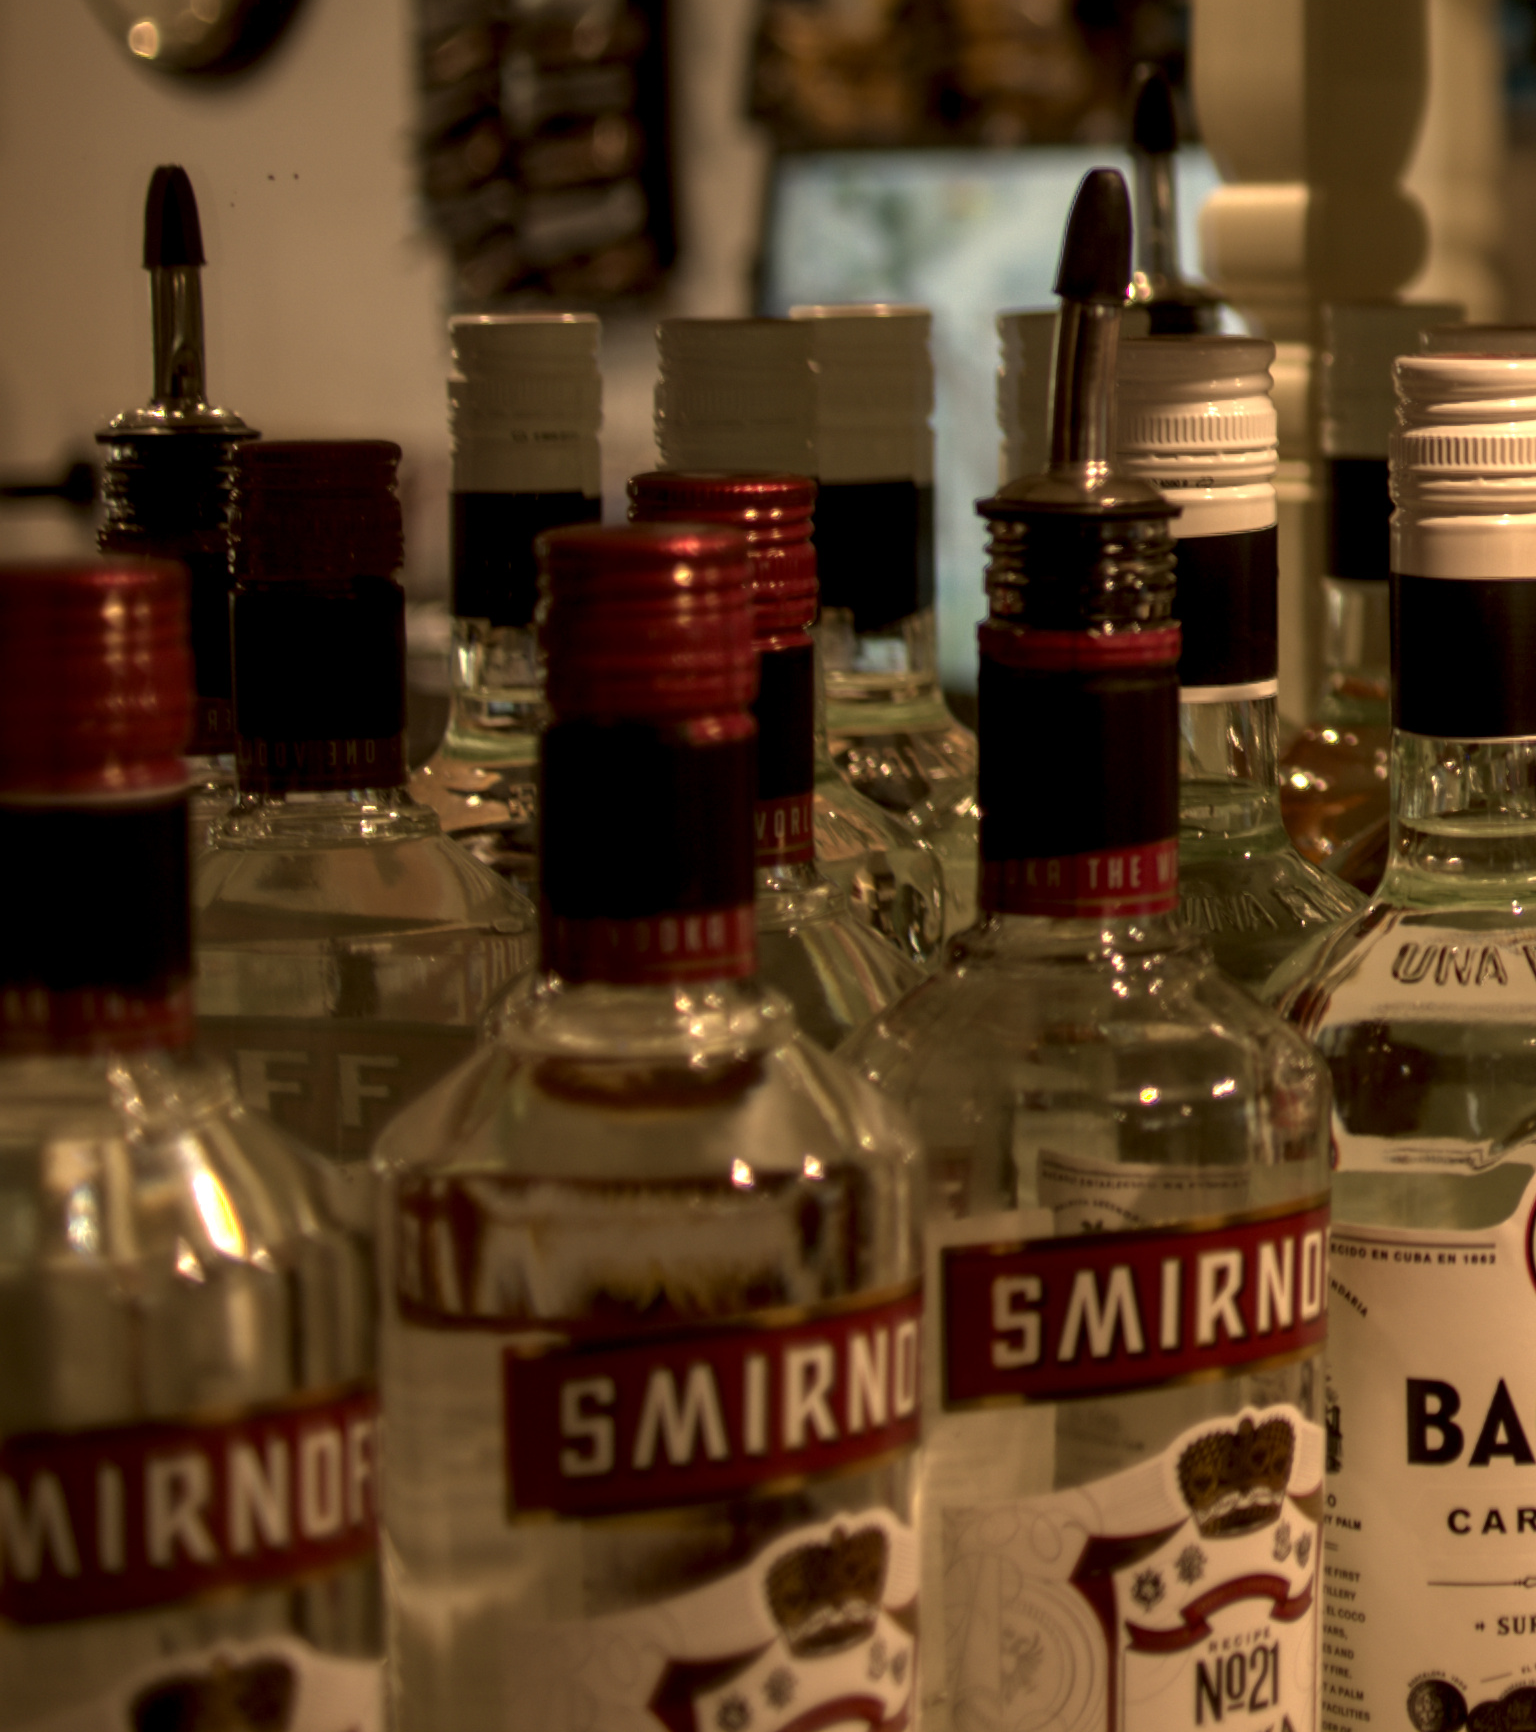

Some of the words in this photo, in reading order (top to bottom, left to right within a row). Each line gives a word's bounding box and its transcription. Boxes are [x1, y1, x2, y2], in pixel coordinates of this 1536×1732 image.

[1088, 857, 1143, 891] THE
[1391, 941, 1508, 987] UNA
[1371, 1248, 1389, 1261] EN
[1394, 1250, 1432, 1264] CUBA
[1437, 1252, 1457, 1265] EN
[1335, 1516, 1362, 1531] PALM
[1334, 1568, 1361, 1583] FIRST
[1326, 1606, 1336, 1618] EL
[1337, 1609, 1366, 1624] COCO
[1208, 1625, 1271, 1654] RECIPE
[1334, 1646, 1355, 1661] AND
[1338, 1684, 1365, 1702] PALM
